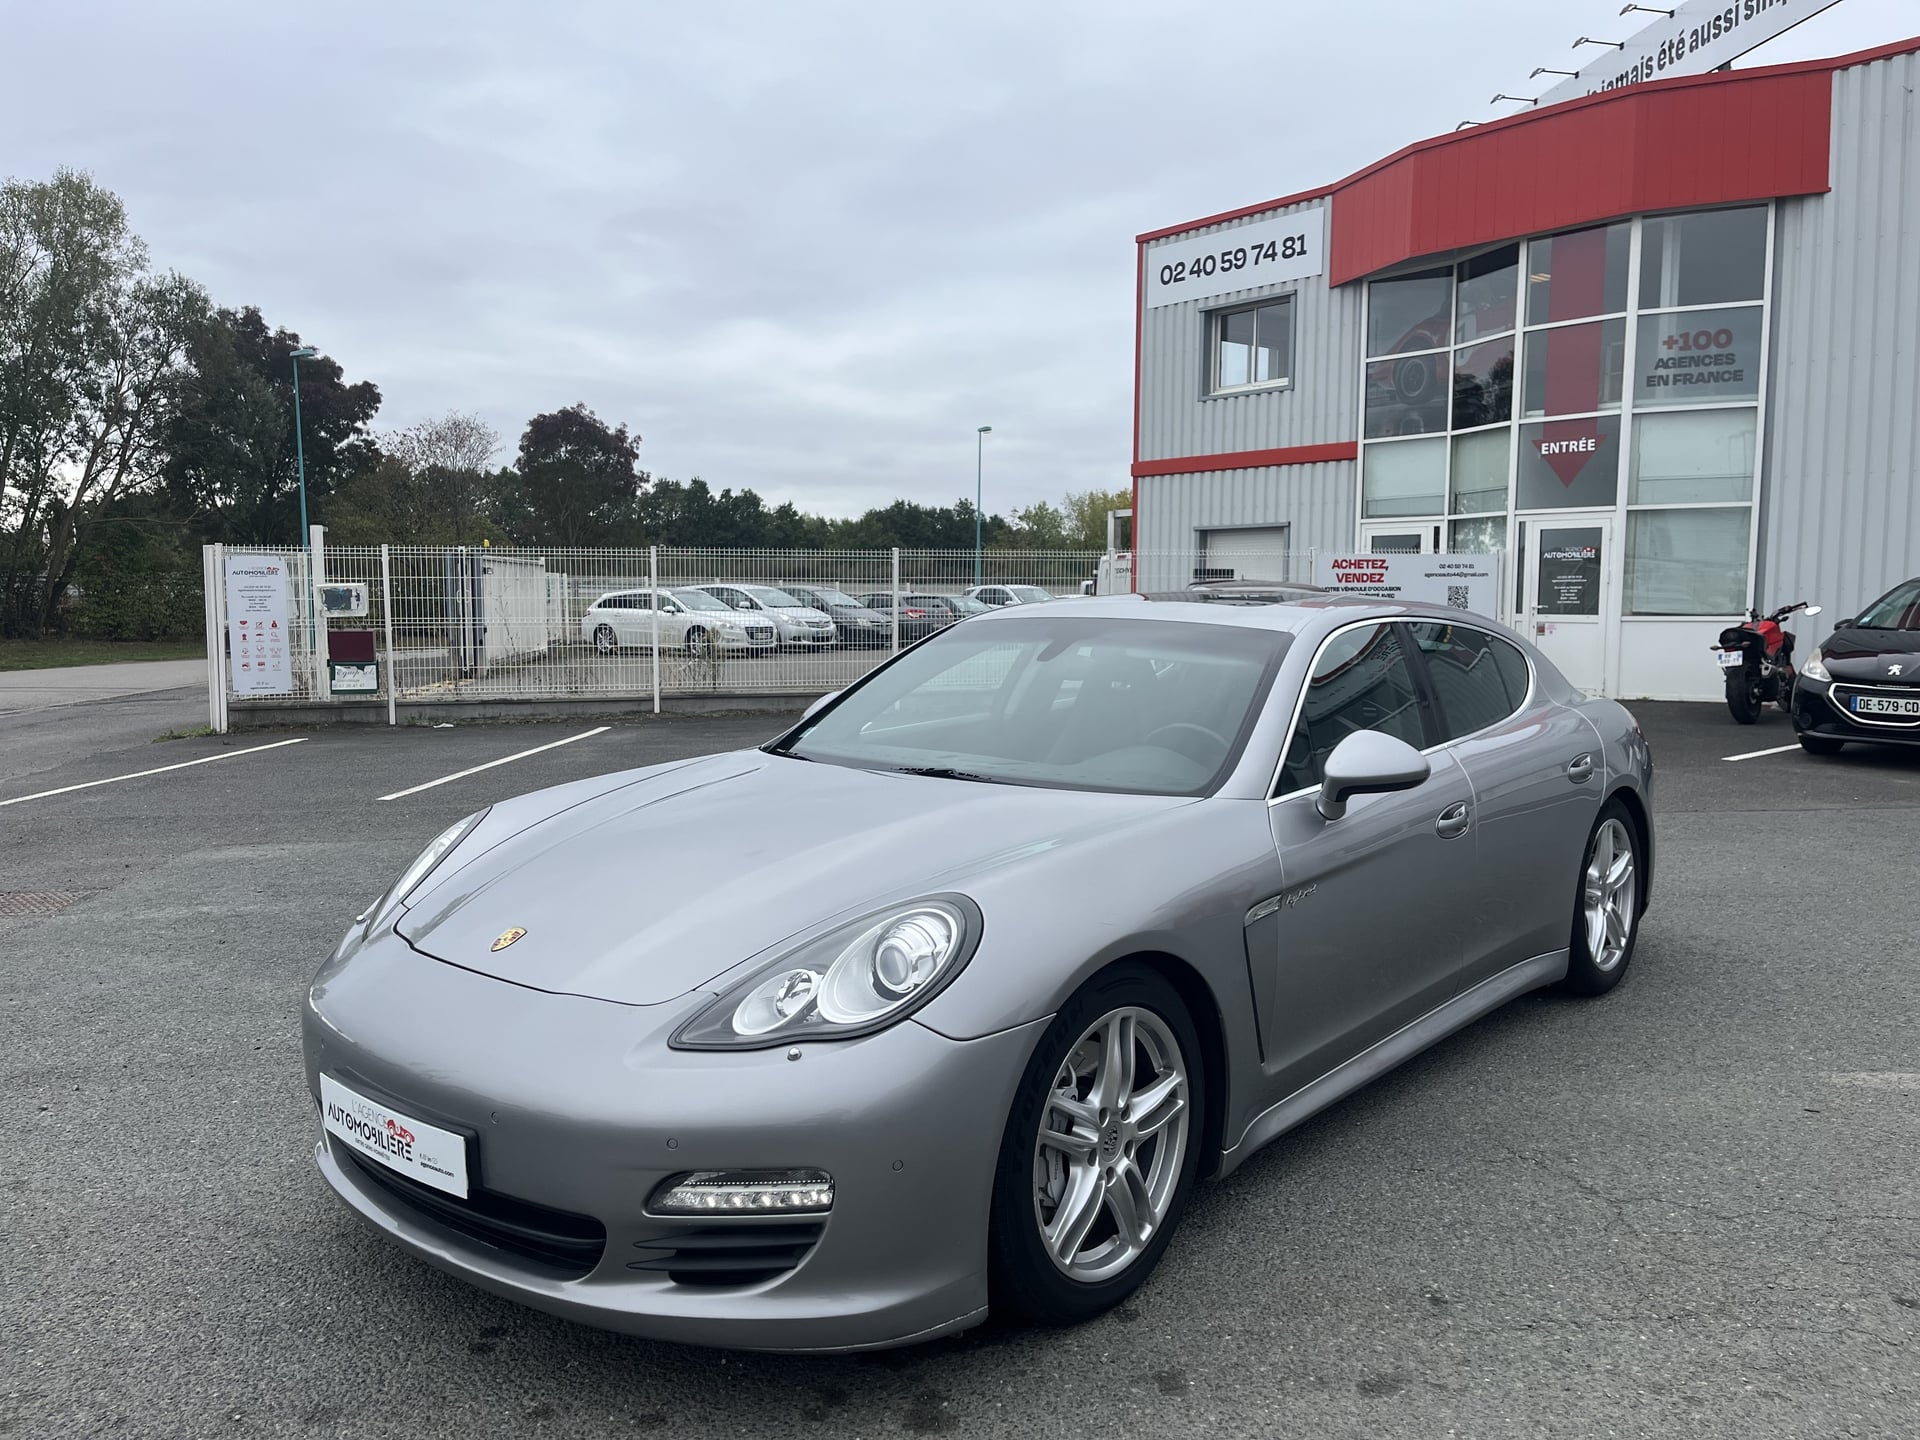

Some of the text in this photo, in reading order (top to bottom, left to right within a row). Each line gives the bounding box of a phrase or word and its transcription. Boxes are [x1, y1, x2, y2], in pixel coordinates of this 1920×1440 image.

[1657, 29, 1685, 71] été
[1689, 0, 1740, 53] aussi
[1160, 233, 1308, 286] 02 40 59 74 81
[1662, 328, 1733, 351] +100
[1653, 352, 1736, 371] AGENCES
[1646, 369, 1744, 388] EN FRANCE
[1540, 437, 1596, 455] ENTRÉE
[1331, 558, 1389, 571] ACHETEZ,
[1335, 572, 1385, 583] VENDEZ
[1859, 698, 1919, 713] DE-579-CD
